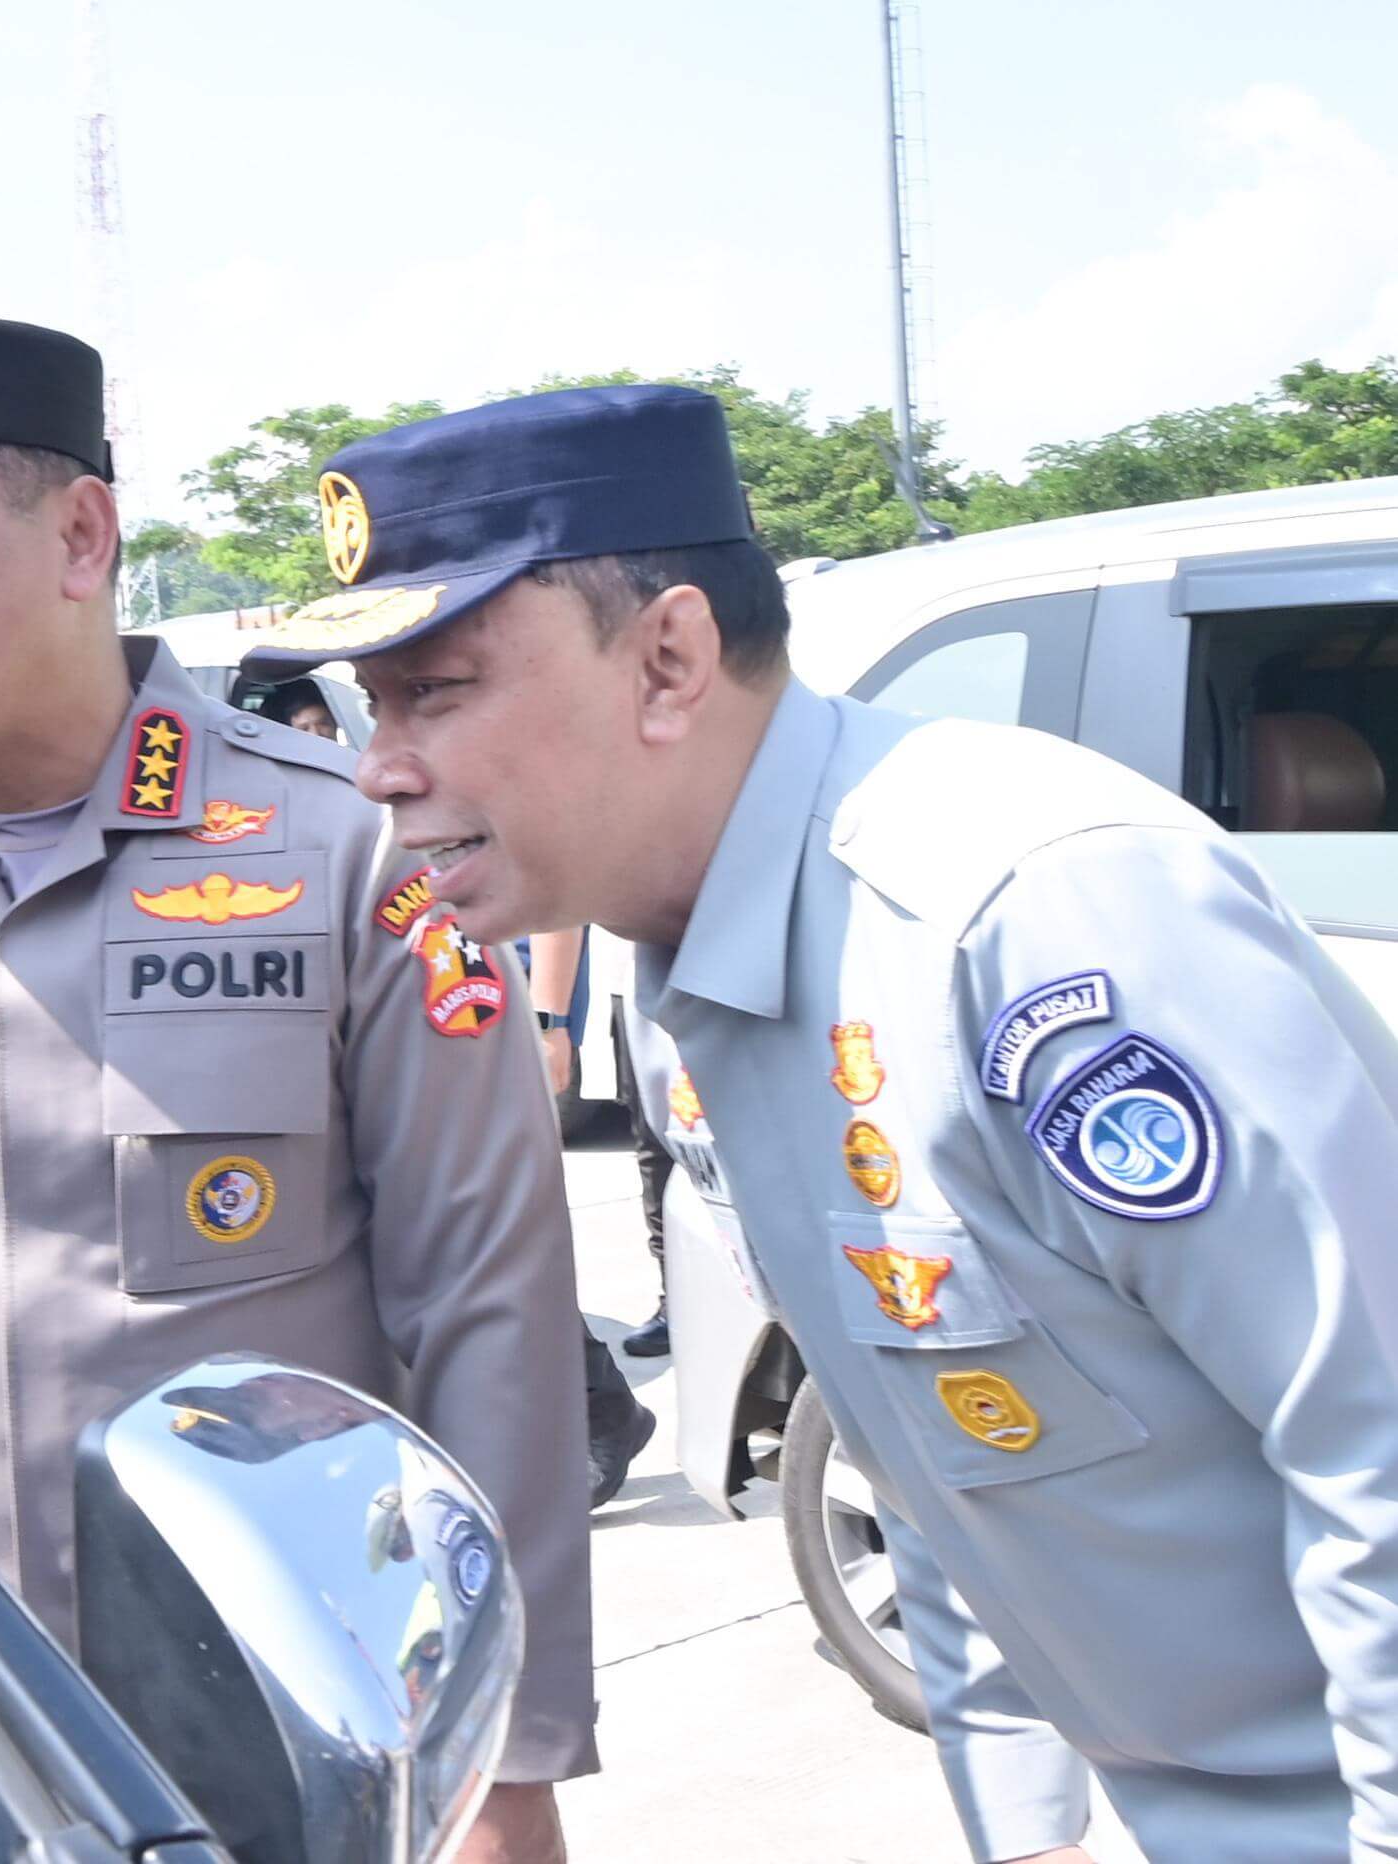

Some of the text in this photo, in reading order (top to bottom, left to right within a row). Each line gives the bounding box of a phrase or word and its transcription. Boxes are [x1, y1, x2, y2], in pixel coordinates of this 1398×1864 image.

[131, 949, 304, 1000] POLRI
[990, 986, 1095, 1091] KANTOR PUSAT
[1043, 1049, 1158, 1153] JASA RAHARJA
